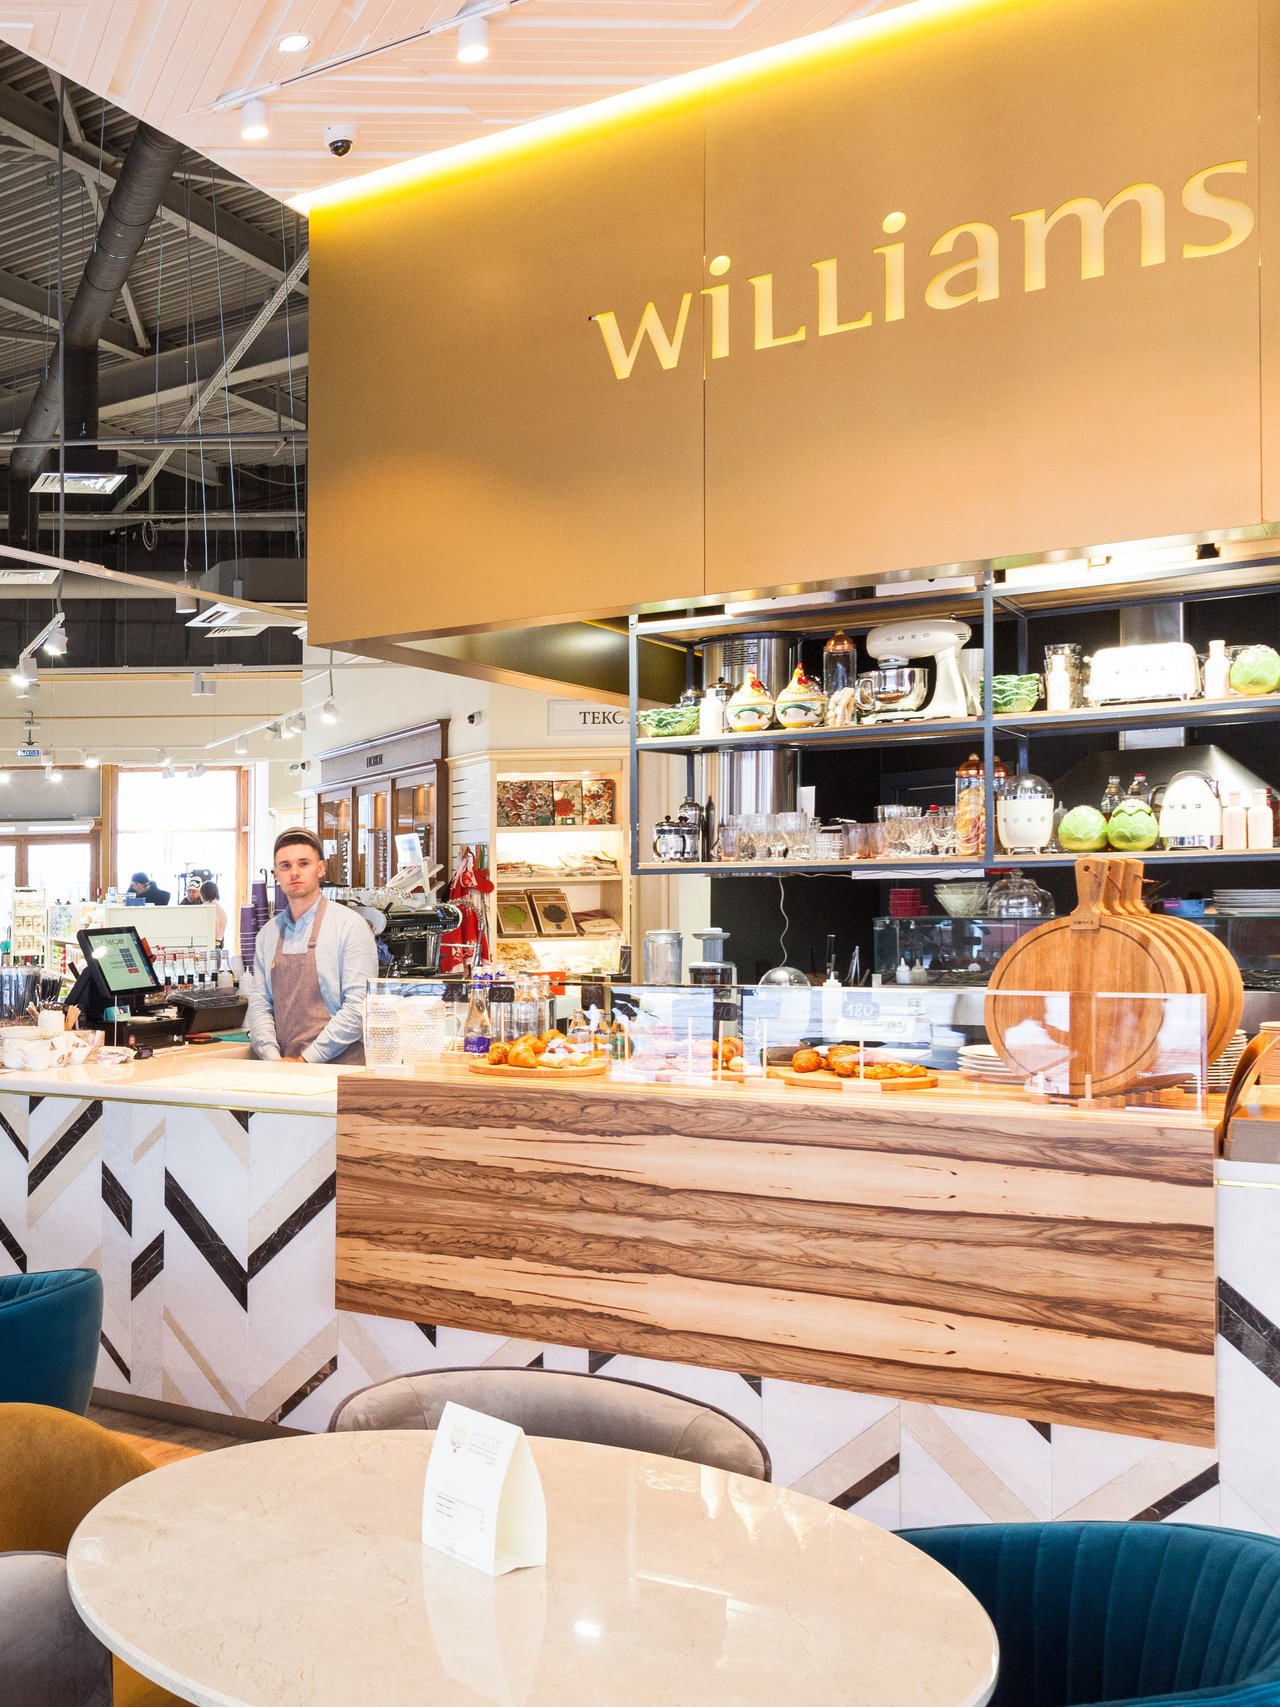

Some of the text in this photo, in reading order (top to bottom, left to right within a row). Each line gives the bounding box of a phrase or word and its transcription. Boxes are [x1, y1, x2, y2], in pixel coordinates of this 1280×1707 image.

[578, 710, 631, 725] ТЕКС
[493, 990, 512, 1000] 250
[845, 1002, 876, 1018] 180
